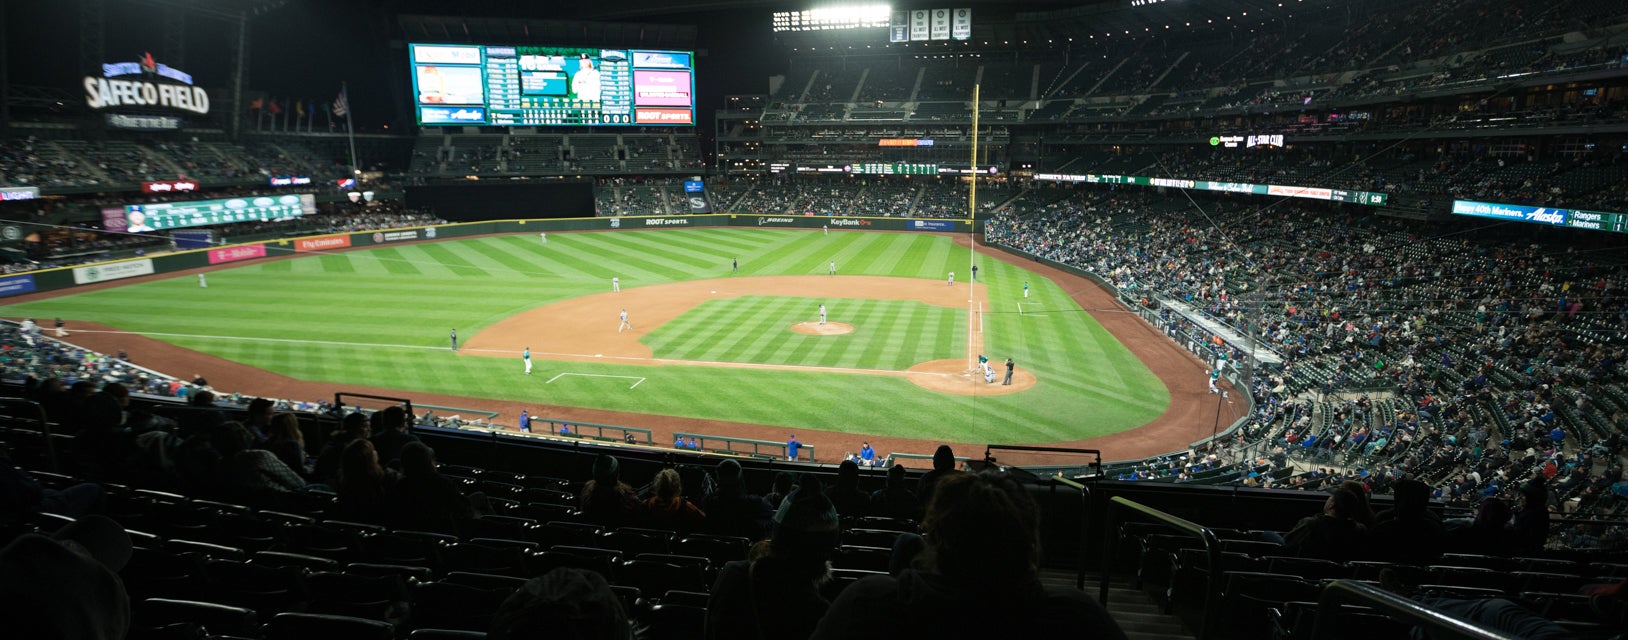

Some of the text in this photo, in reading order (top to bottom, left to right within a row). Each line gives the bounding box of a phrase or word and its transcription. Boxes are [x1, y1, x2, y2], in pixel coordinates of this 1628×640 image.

[84, 76, 210, 114] SAFECO FIELD
[603, 114, 629, 123] 0 0 0
[1476, 205, 1491, 214] 40th
[1491, 206, 1524, 217] Mariners.
[1574, 210, 1622, 222] Rangers 1
[1573, 220, 1600, 229] Mariners
